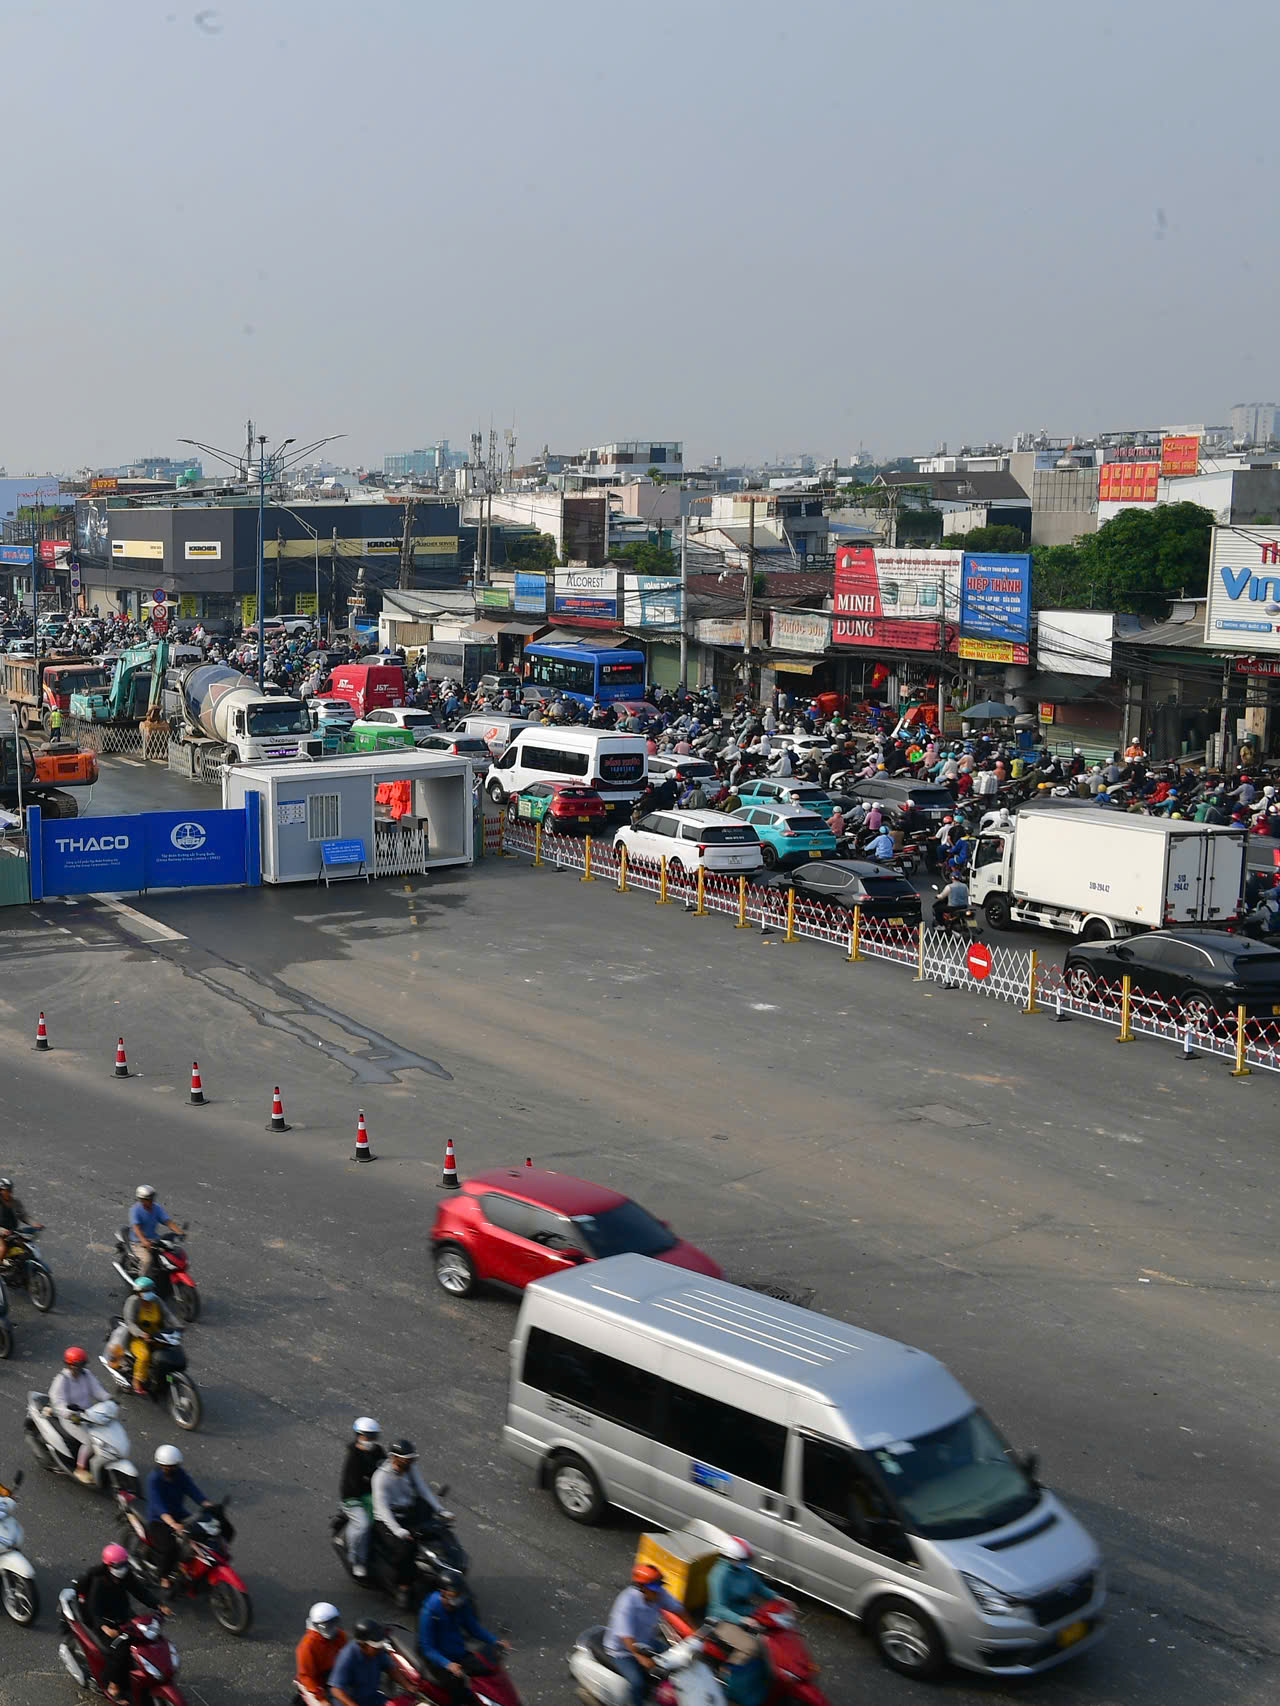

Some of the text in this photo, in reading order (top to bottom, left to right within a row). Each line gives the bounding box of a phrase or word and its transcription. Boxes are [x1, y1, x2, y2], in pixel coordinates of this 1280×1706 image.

[566, 571, 604, 588] ALCOREST
[968, 575, 988, 593] HIỆP
[838, 594, 875, 612] MINH
[55, 835, 129, 852] THACO
[1173, 883, 1189, 891] 294.42
